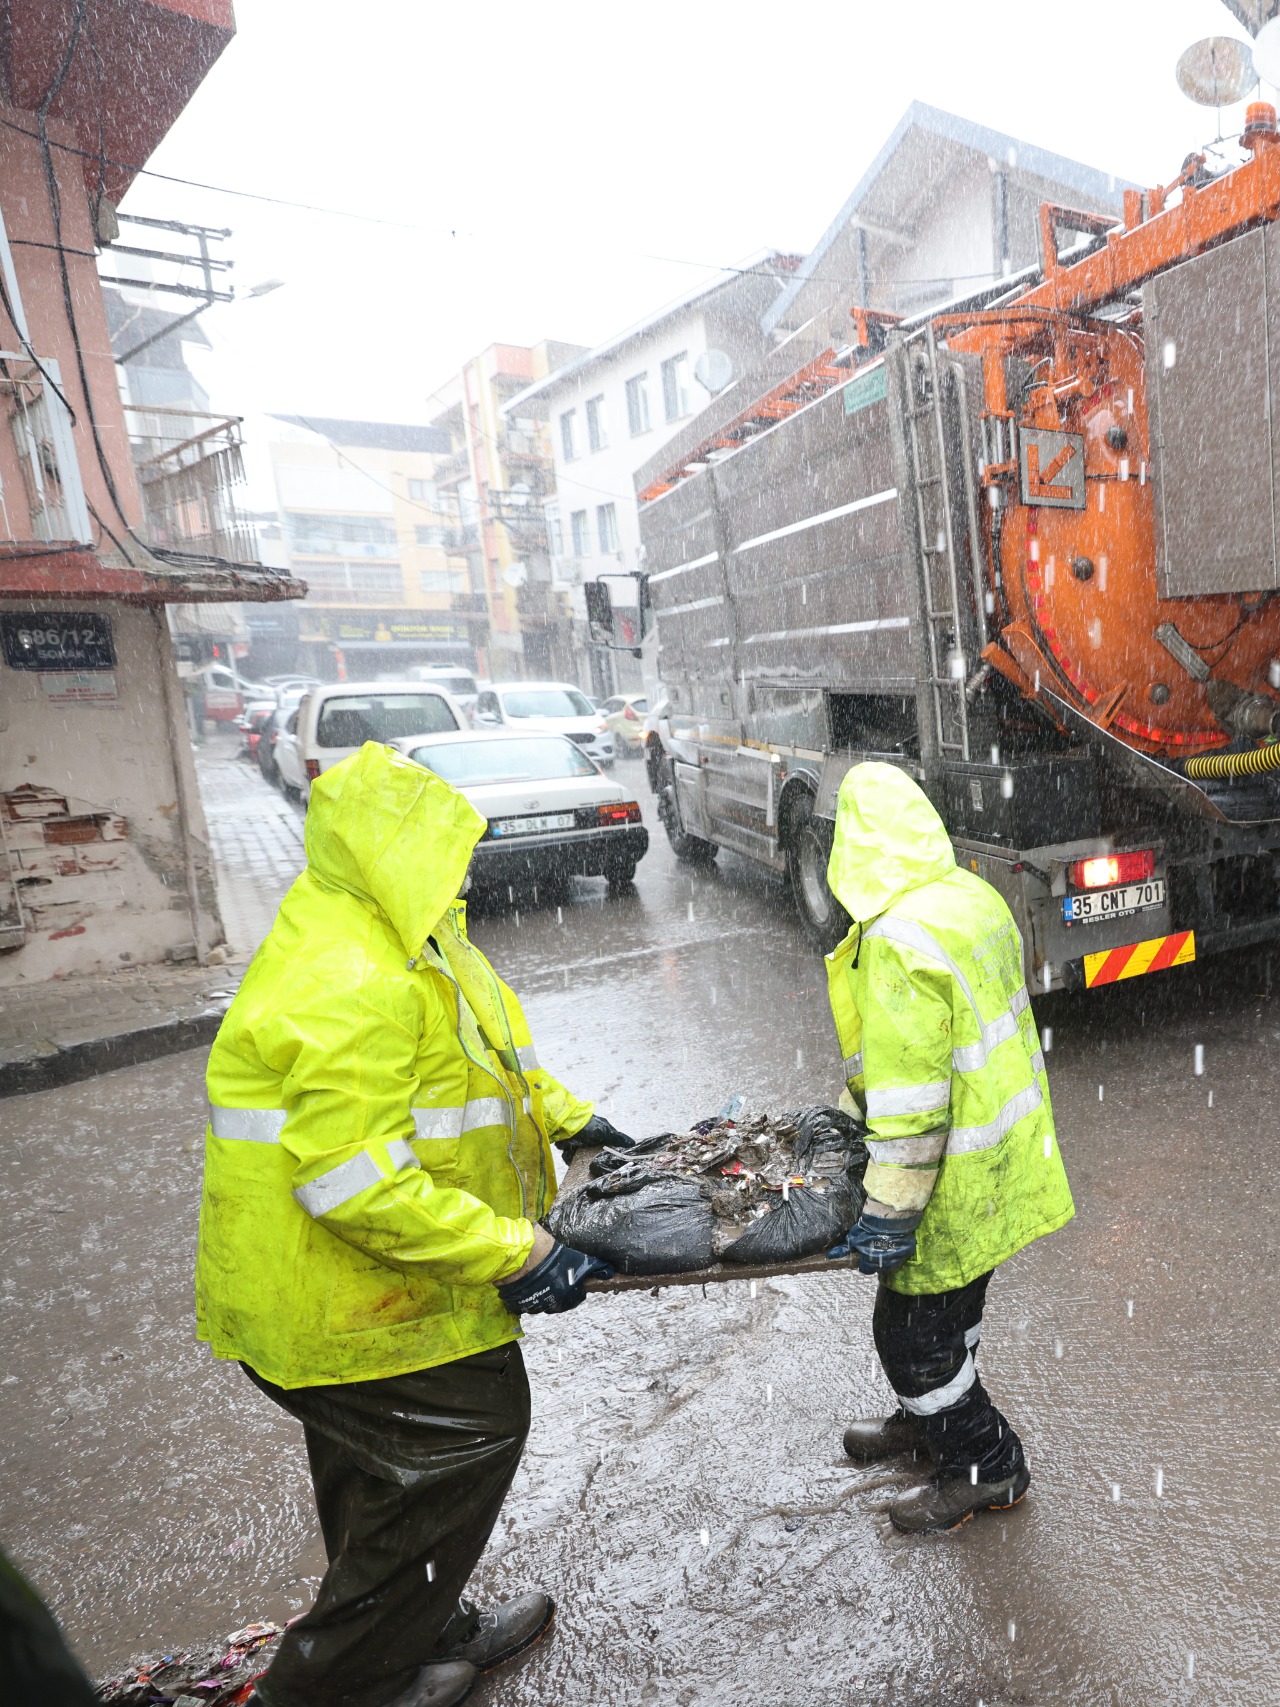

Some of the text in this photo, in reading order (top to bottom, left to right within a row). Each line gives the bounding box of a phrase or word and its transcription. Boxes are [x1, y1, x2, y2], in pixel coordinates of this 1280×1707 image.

[502, 821, 517, 833] 35
[557, 815, 571, 827] 07
[1073, 896, 1092, 917] 35
[1101, 889, 1127, 912] CNT
[1136, 883, 1160, 906] 701
[1082, 908, 1136, 924] BESLER OTO
